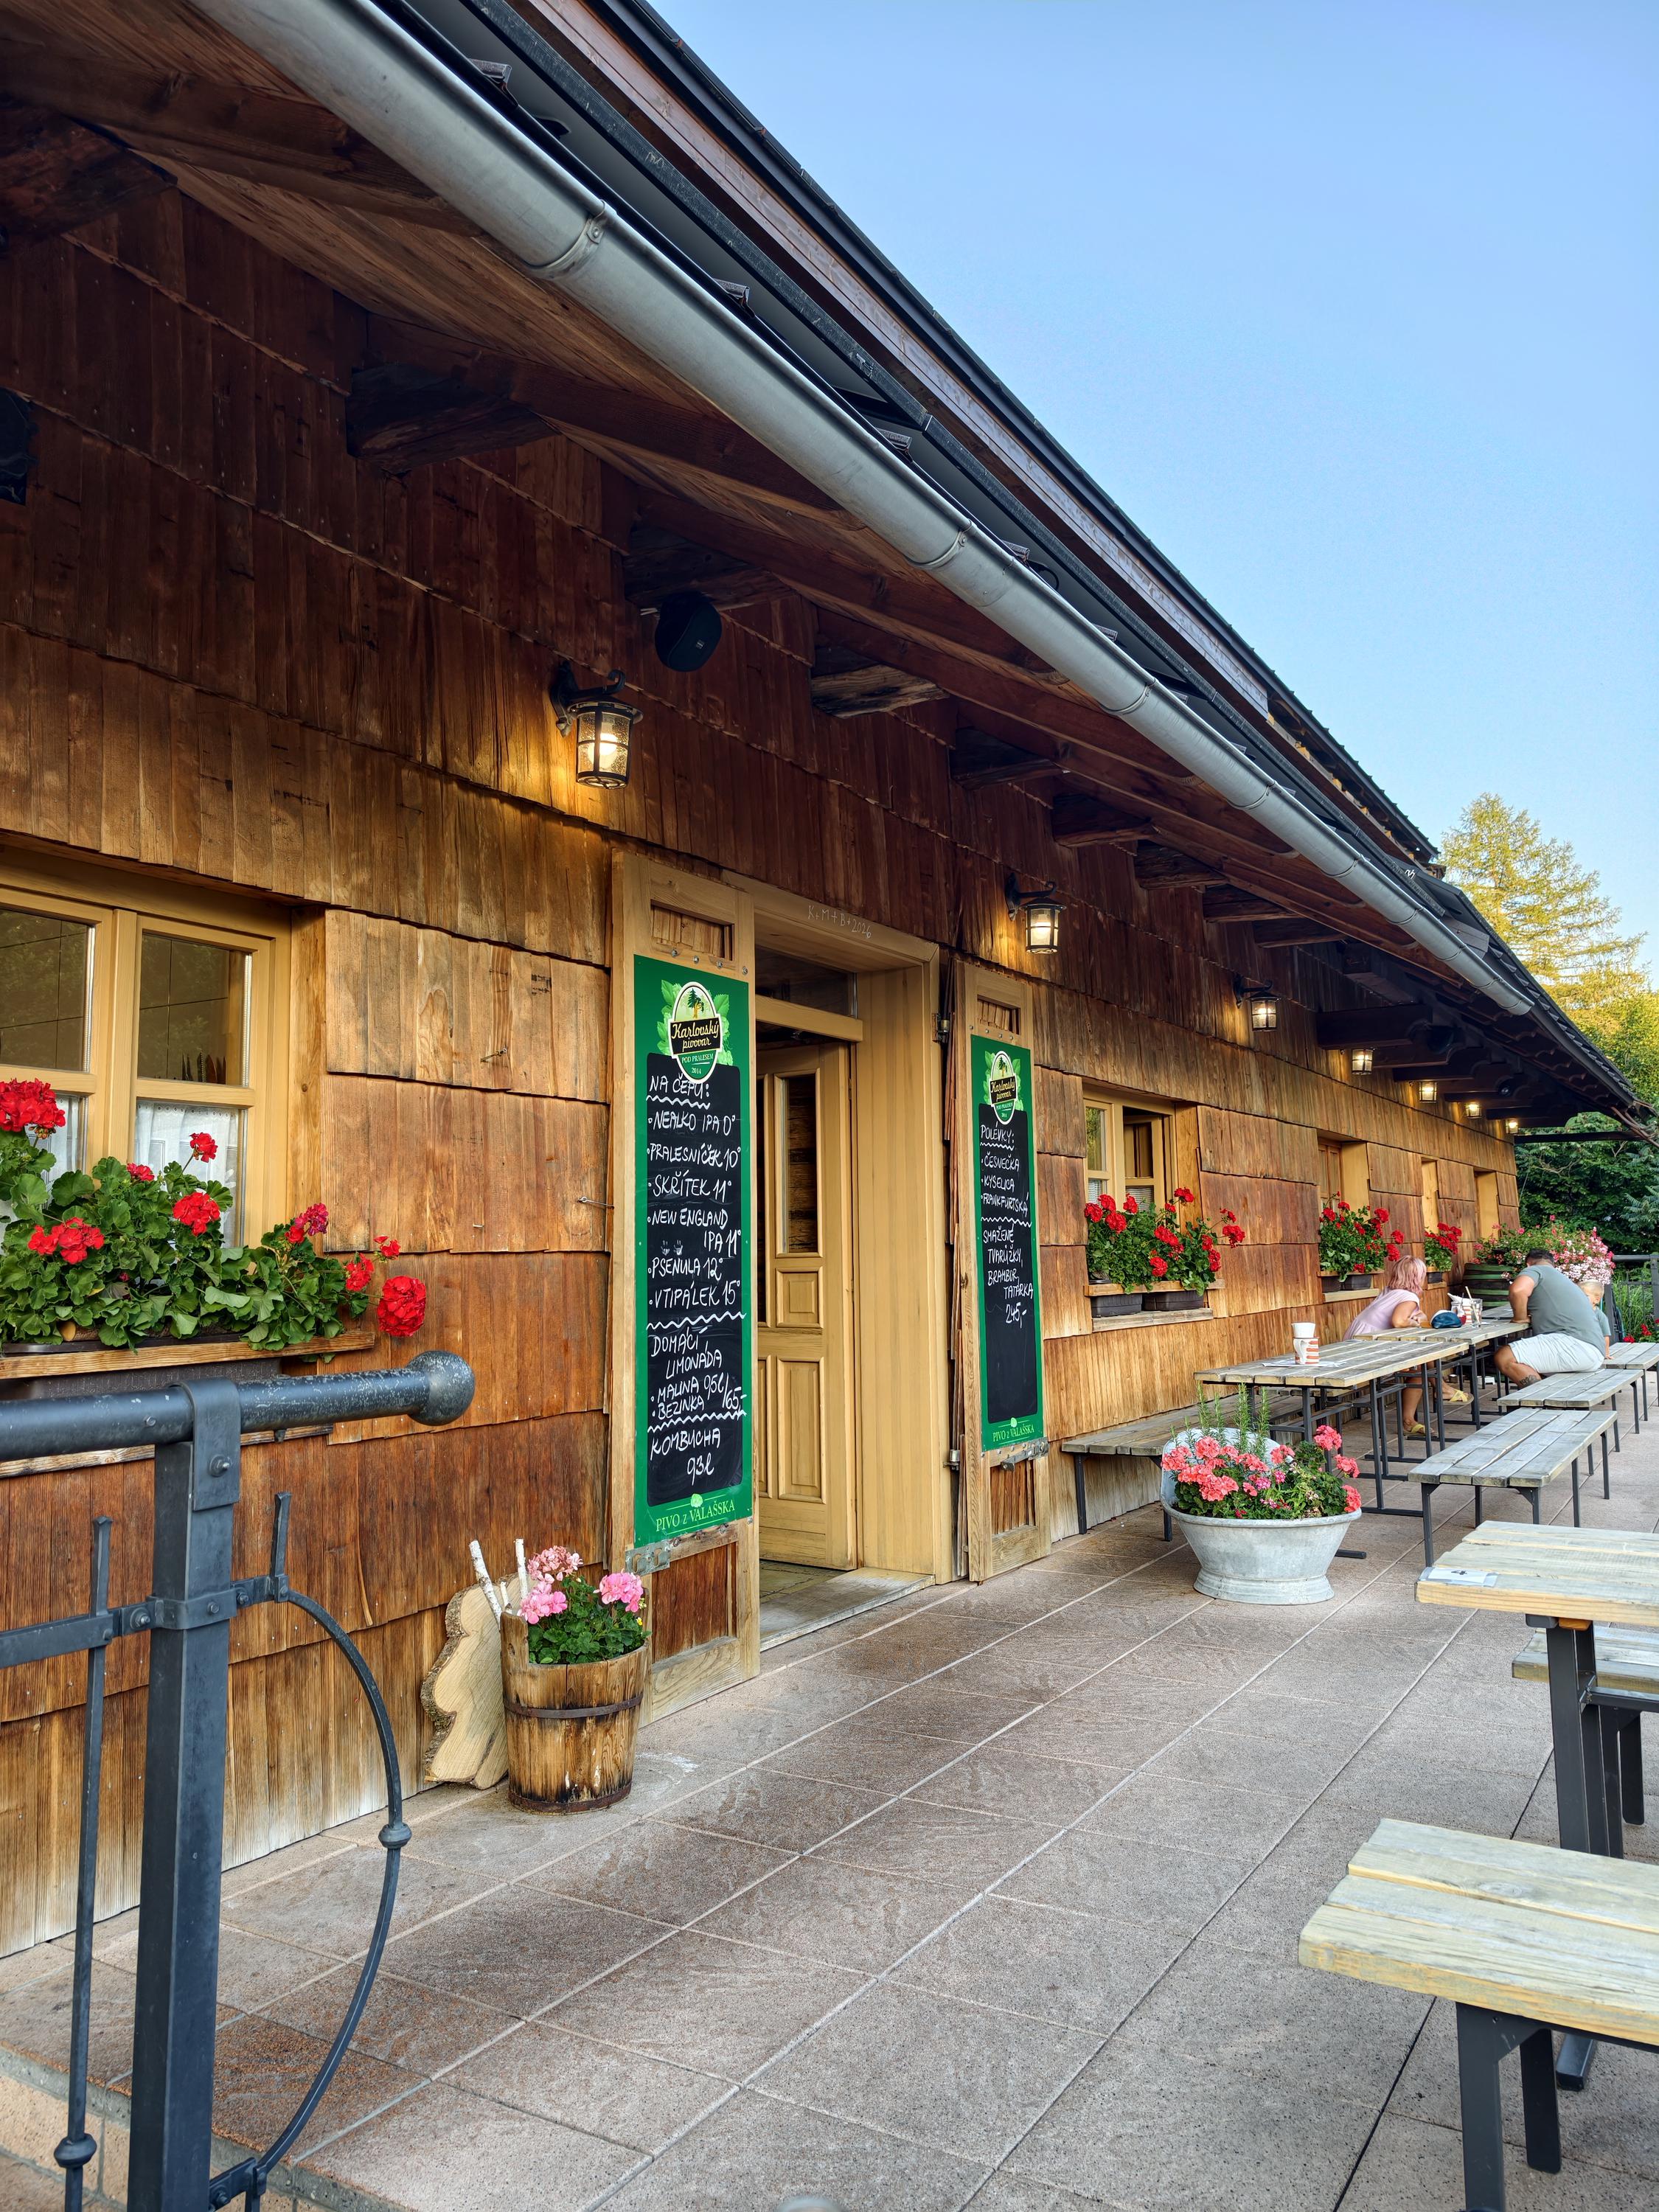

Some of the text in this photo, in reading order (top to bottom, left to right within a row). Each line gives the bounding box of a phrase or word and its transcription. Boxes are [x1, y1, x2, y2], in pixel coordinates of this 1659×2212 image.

[672, 1020, 720, 1039] Karlovský
[682, 1037, 712, 1052] pivovar
[692, 1053, 714, 1062] PRALESEM
[649, 1072, 709, 1099] NA ČEPU:
[653, 1110, 696, 1131] NEALKO
[702, 1114, 720, 1134] IPA
[980, 1121, 1015, 1144] POLÉVKY:
[650, 1142, 723, 1168] PRALESNÍČEK
[984, 1151, 1020, 1172] ČESNEČKA
[653, 1169, 711, 1197] SKŘÍTEK
[984, 1175, 1015, 1193] KYSELICA
[983, 1192, 1029, 1218] FRANKFURTSKÁ
[651, 1208, 728, 1230] NEW ENGLAND
[703, 1230, 723, 1253] IPA
[983, 1223, 1015, 1244] SMAŽENÉ
[655, 1280, 720, 1310] VTIPÁLEK
[650, 1326, 708, 1357] DOMÁCÍ
[666, 1340, 723, 1380] LIMONÁDA
[657, 1376, 699, 1403] MALINA
[658, 1395, 705, 1420] BEZINKA
[650, 1427, 721, 1461] KOMBUCHA
[992, 1430, 1006, 1442] PIVO
[1010, 1423, 1034, 1438] VALAŠSKA
[655, 1514, 680, 1531] PIVO
[689, 1500, 735, 1522] VALAŠSKA
